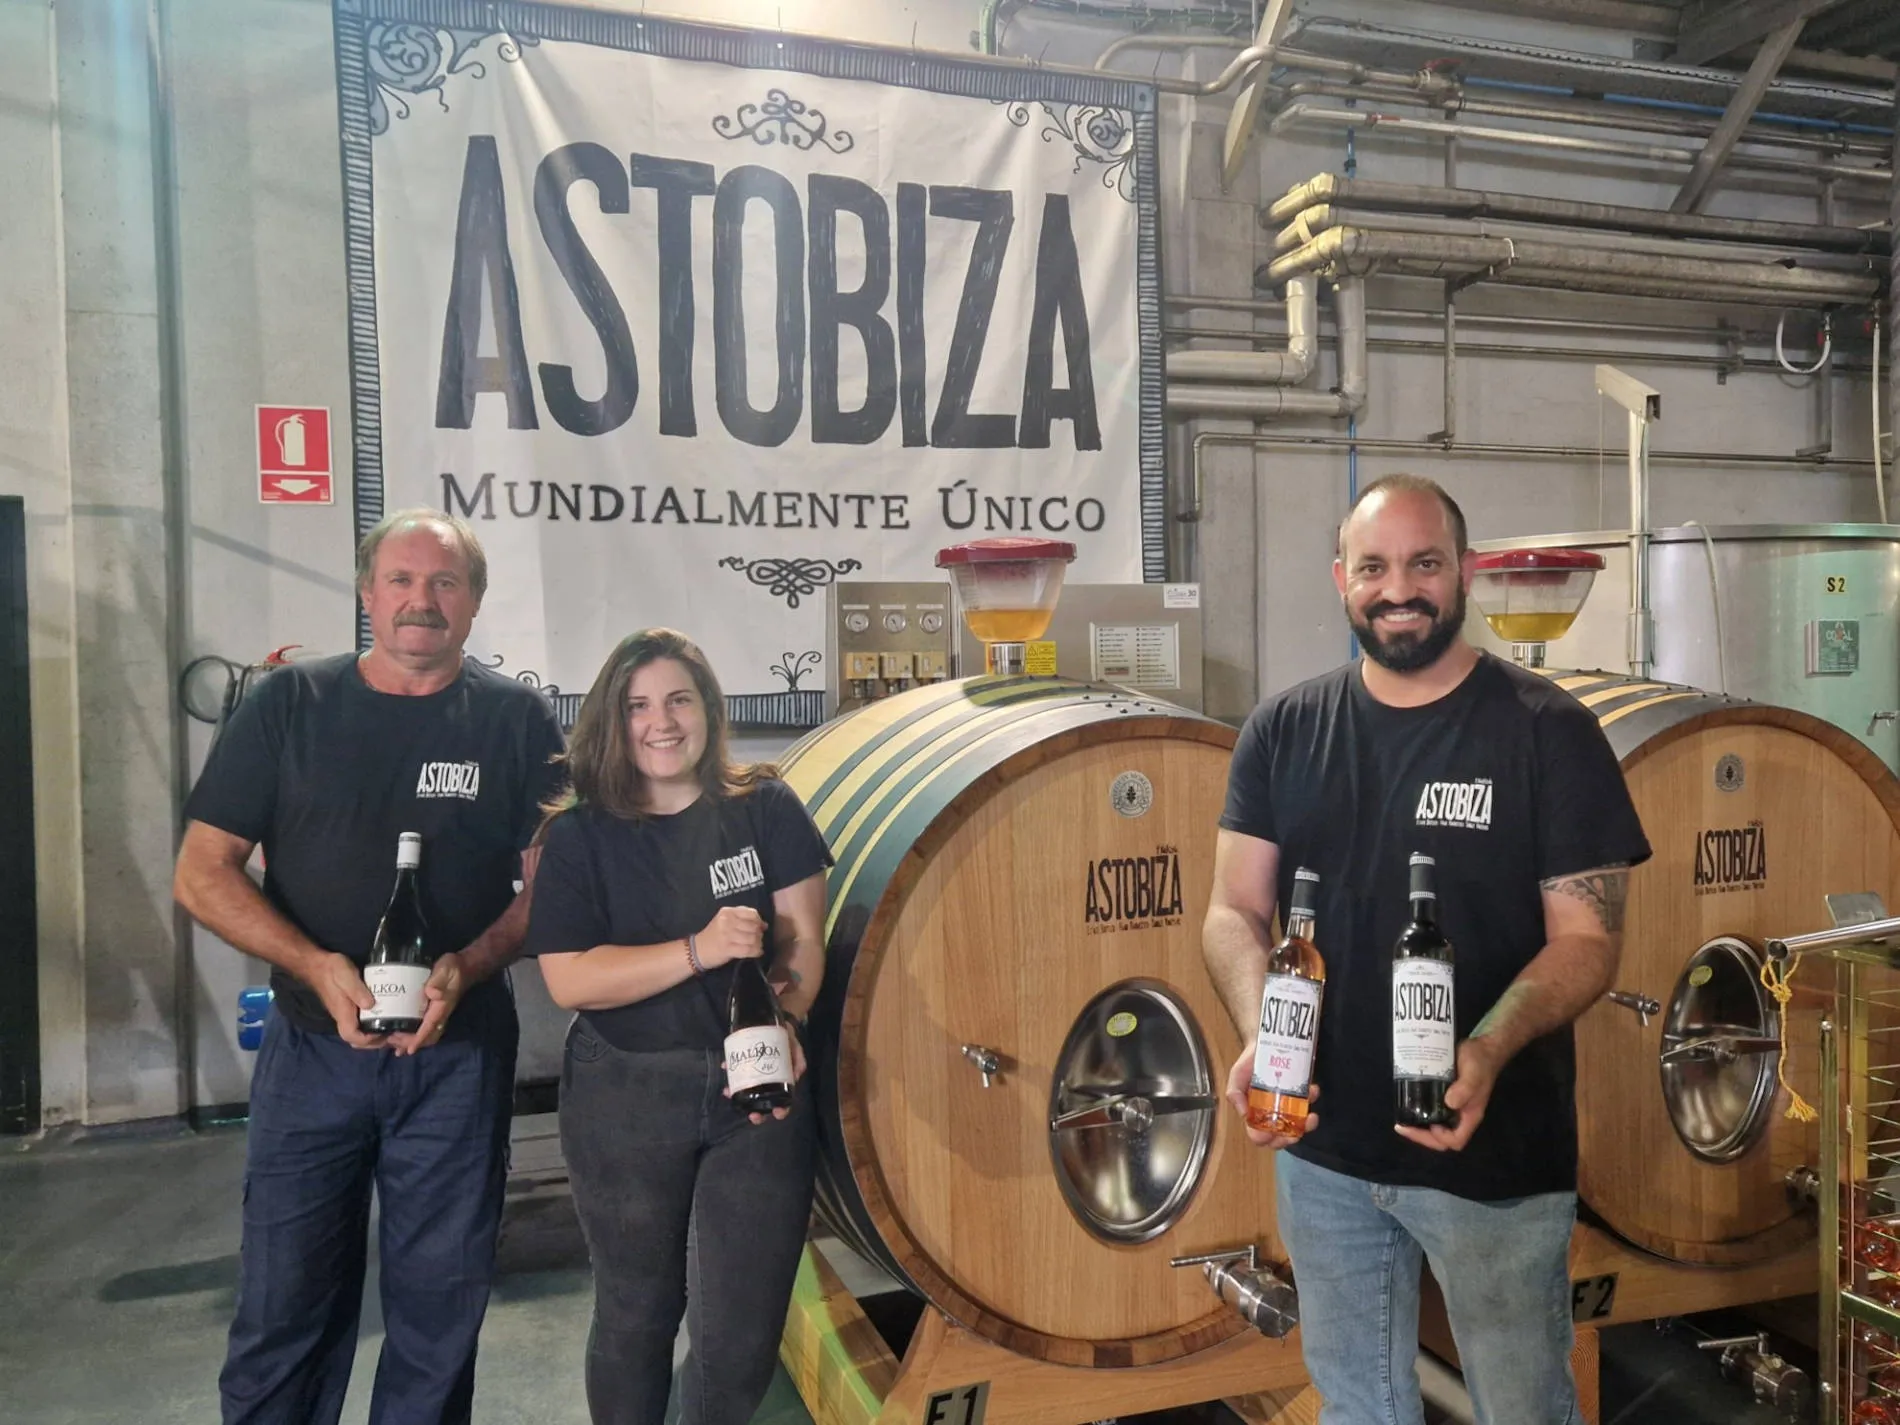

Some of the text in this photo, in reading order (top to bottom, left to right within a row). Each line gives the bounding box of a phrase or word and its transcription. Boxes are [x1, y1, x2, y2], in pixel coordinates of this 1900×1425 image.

[434, 134, 1102, 452] ASTOBIZA
[416, 762, 479, 796] ASTOBIZA
[1415, 782, 1492, 824] ASTOBIZA
[709, 849, 764, 894] ASTOBIZA
[1694, 828, 1766, 885] ASTOBIZA
[1085, 854, 1183, 923] ASTOBIZA
[1260, 997, 1316, 1041] ASTOBIZA
[1395, 982, 1452, 1024] ASTOBIZA
